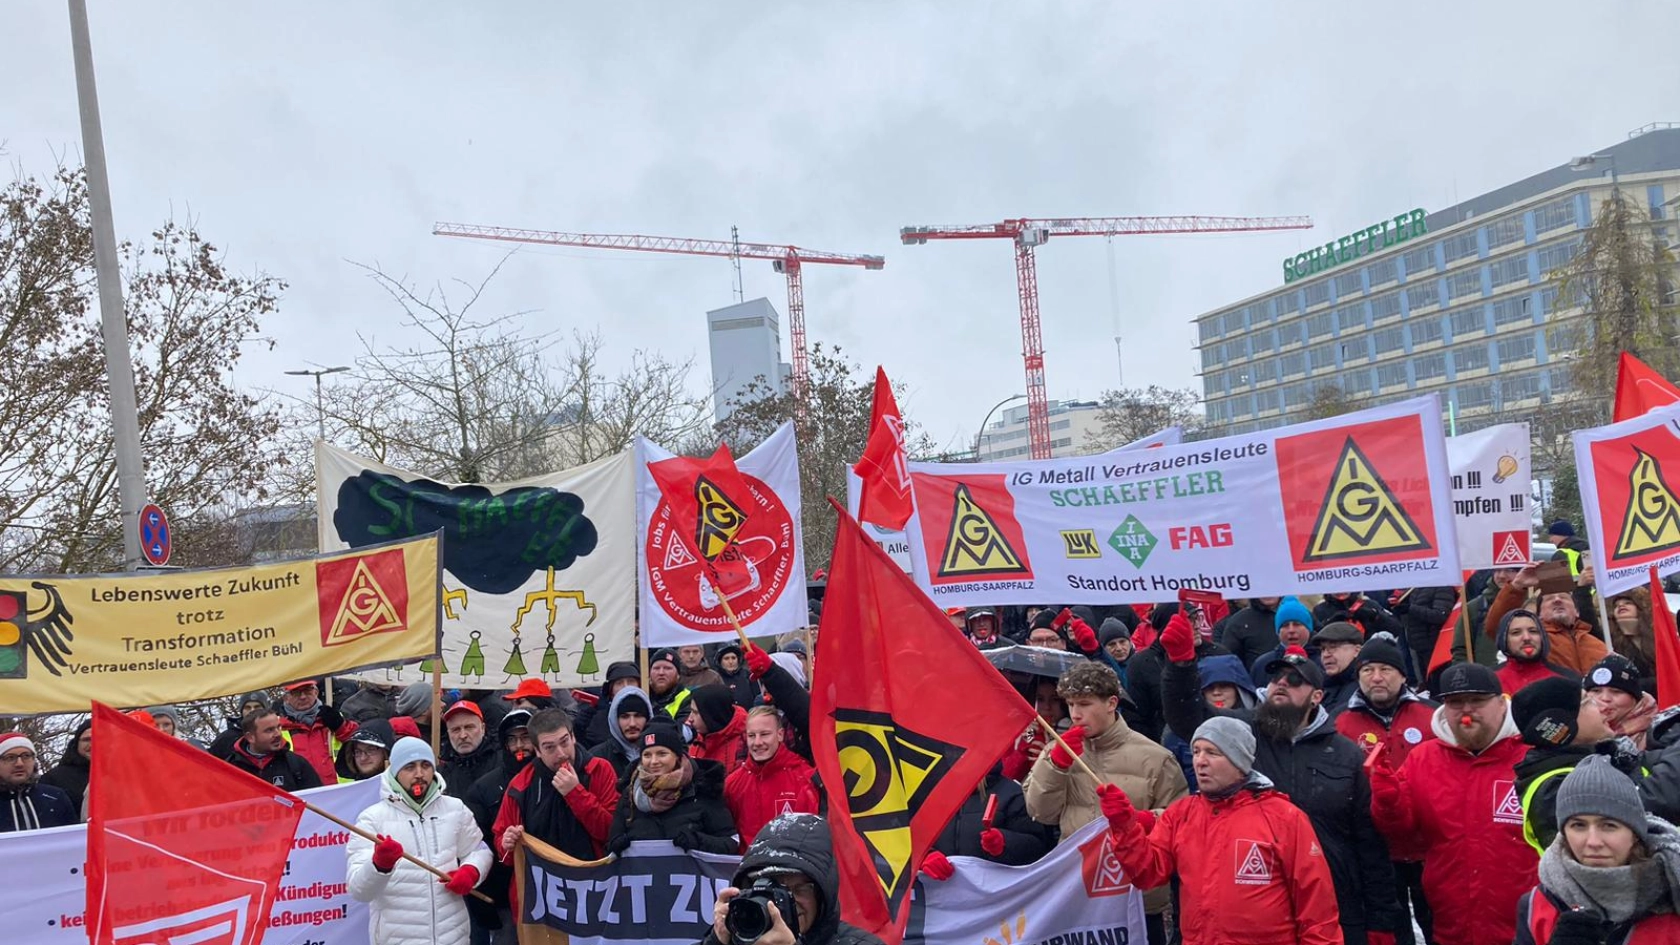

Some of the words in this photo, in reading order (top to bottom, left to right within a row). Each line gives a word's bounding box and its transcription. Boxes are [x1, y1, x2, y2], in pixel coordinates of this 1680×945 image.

[1283, 208, 1429, 284] SCHAEFFLER
[1012, 472, 1033, 486] IG
[1039, 466, 1095, 485] Metall
[1102, 442, 1268, 479] Vertrauensleute
[1050, 470, 1225, 507] SCHAEFFLER
[652, 521, 666, 549] Jobs
[1169, 523, 1233, 550] FAG
[651, 566, 667, 592] IGM
[1067, 574, 1148, 591] Standort
[1151, 573, 1250, 592] Homburg
[1297, 559, 1439, 583] HOMBURG-SAARPFALZ
[91, 584, 222, 603] Lebenswerte
[228, 572, 300, 595] Zukunft
[933, 581, 1035, 595] HOMBURG-SAARPFALZ
[176, 608, 224, 626] trotz
[121, 626, 276, 652] Transformation
[69, 657, 192, 675] Vertrauensleute
[197, 648, 268, 667] Schaeffler
[272, 641, 303, 657] Bühl
[530, 865, 653, 924] JETZT
